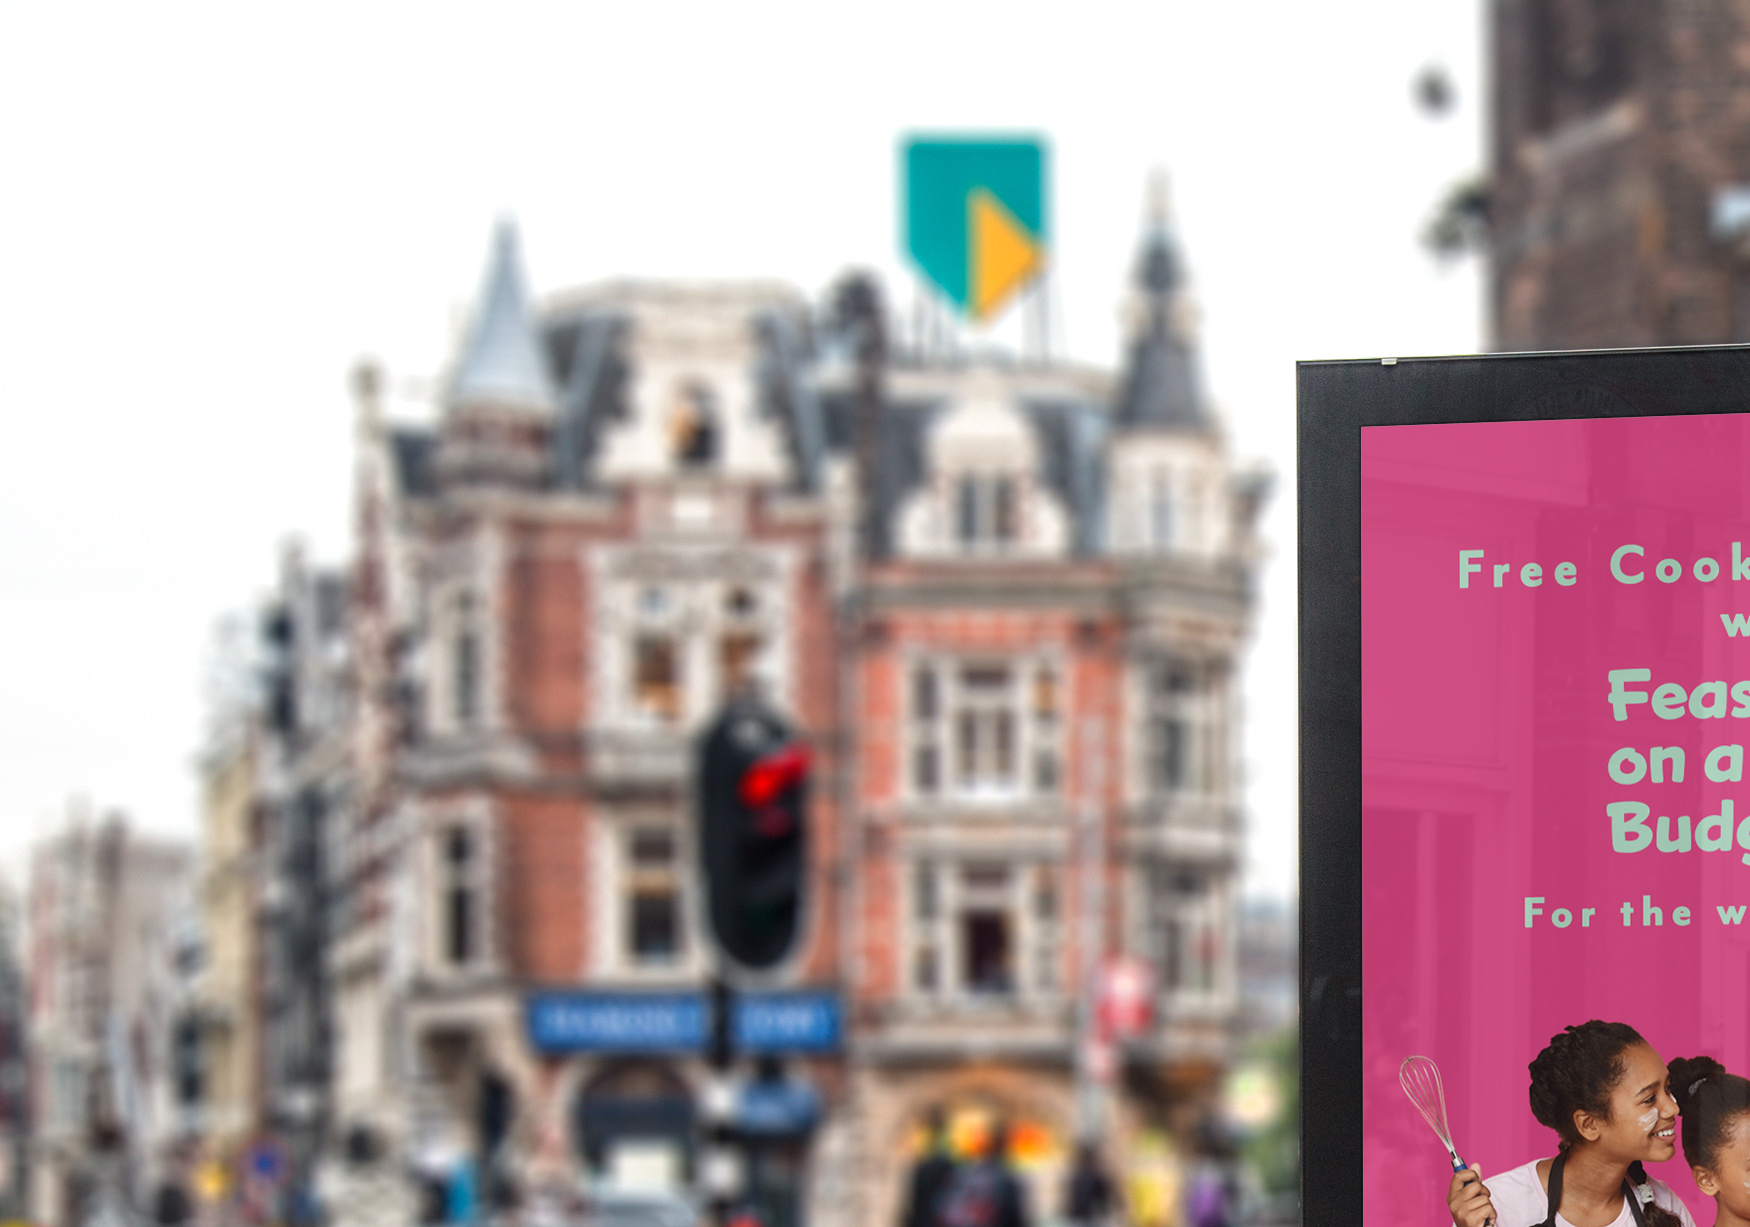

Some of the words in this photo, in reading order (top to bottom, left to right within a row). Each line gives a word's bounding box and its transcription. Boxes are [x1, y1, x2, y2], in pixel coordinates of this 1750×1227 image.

[1458, 549, 1577, 589] Free
[1606, 746, 1686, 786] on
[1703, 743, 1744, 783] a
[1524, 896, 1597, 929] For
[1619, 894, 1692, 927] the
